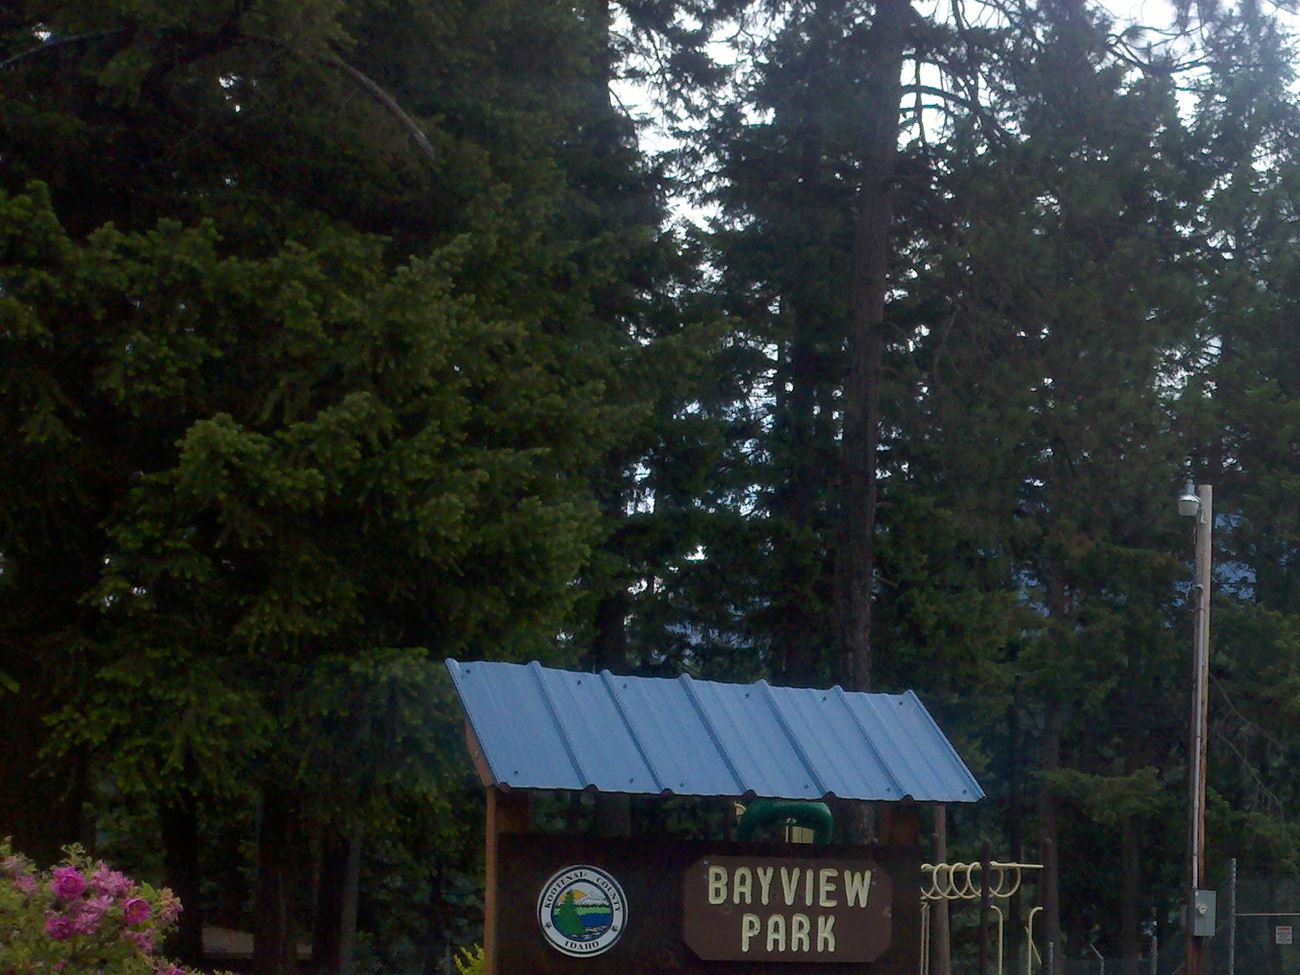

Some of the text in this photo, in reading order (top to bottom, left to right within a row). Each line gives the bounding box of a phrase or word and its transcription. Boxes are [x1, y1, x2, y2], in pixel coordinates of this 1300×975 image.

[708, 865, 872, 908] BAYVIEW
[564, 941, 599, 950] IDAHO
[741, 913, 836, 952] PARK
